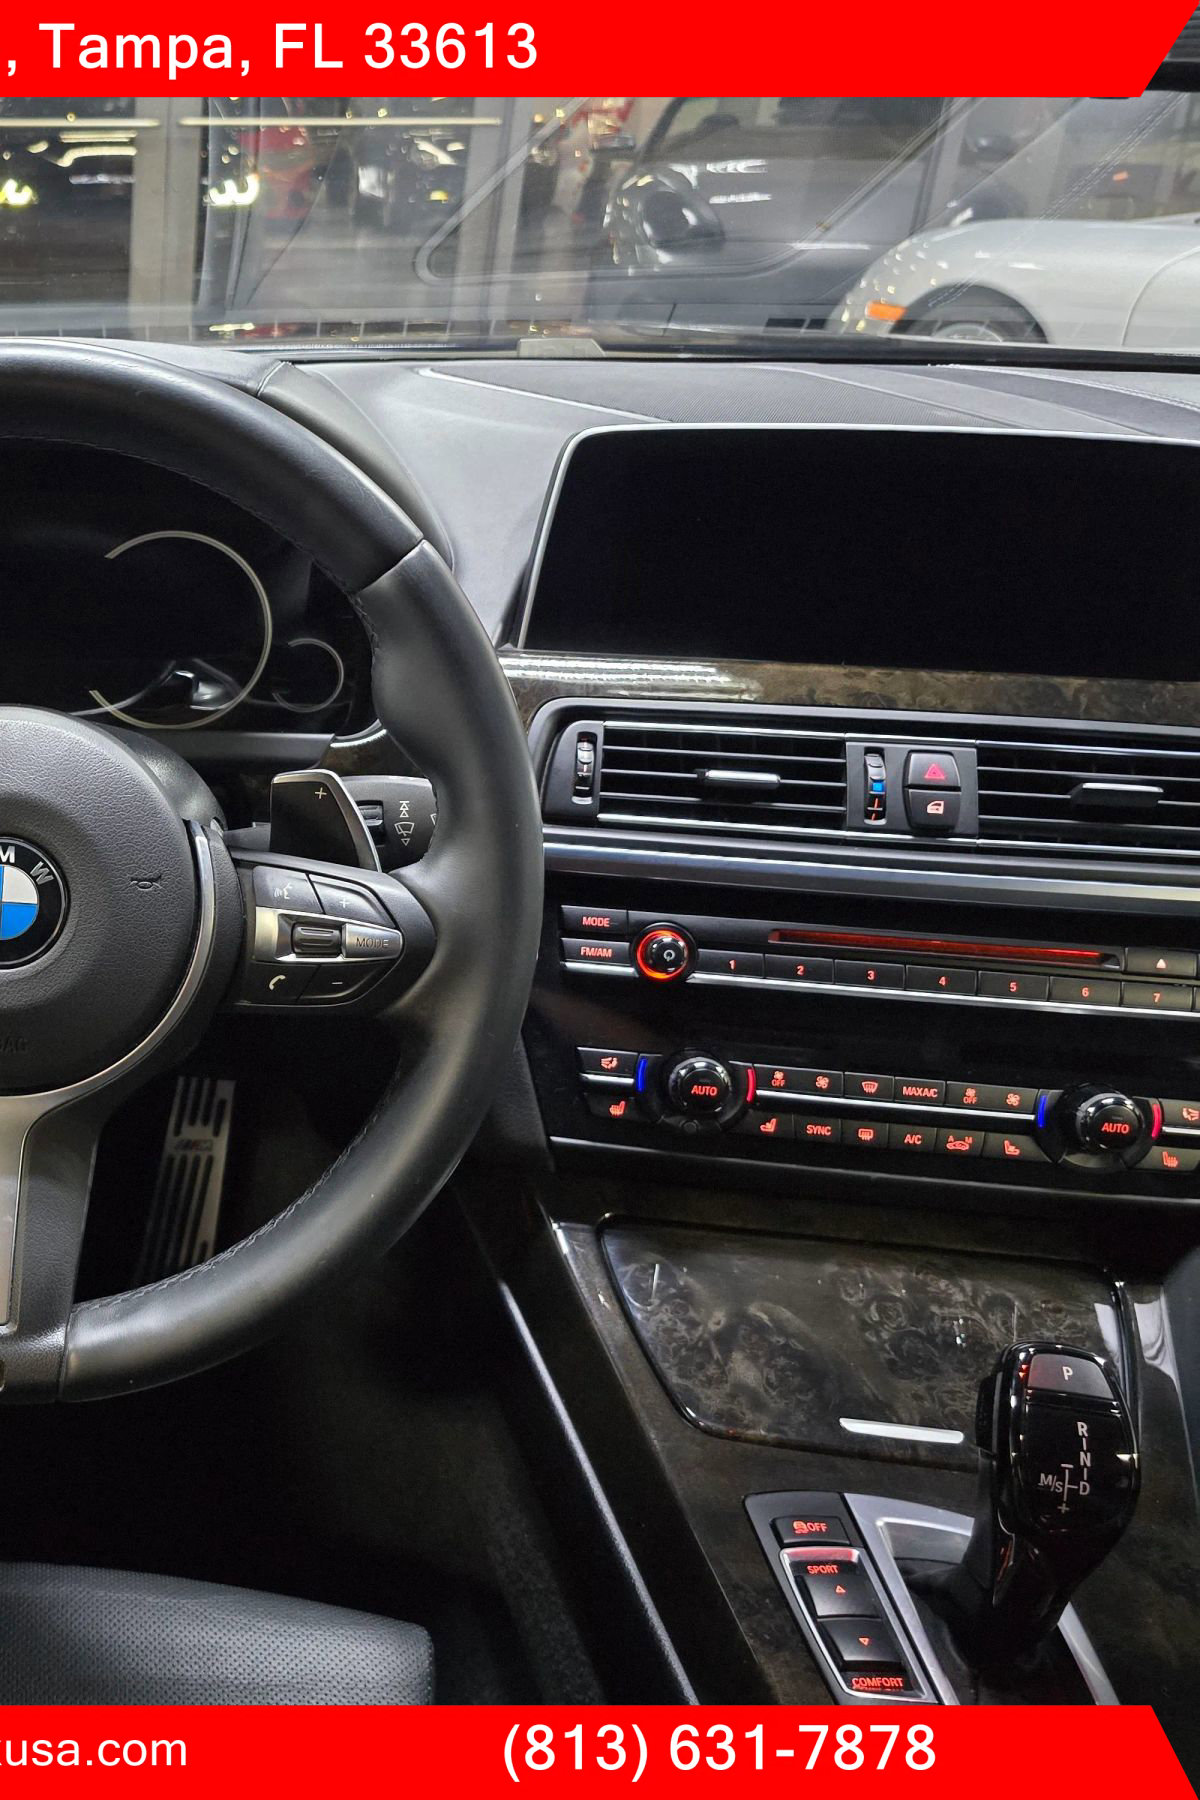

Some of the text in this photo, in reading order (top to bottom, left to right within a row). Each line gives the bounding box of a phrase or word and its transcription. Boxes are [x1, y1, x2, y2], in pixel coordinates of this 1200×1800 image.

[582, 916, 610, 928] MODE
[355, 936, 389, 949] MODE
[580, 946, 612, 958] FM/AM
[796, 965, 804, 976] 2
[867, 970, 875, 981] 3
[938, 976, 946, 986] 4
[1009, 981, 1017, 992] 5
[1081, 987, 1089, 998] 6
[1153, 992, 1161, 1003] 7
[771, 1078, 785, 1087] OFF
[691, 1085, 718, 1096] AUTO
[963, 1096, 977, 1105] OFF
[806, 1124, 832, 1136] SYNC
[1101, 1122, 1130, 1134] AUTO
[904, 1134, 922, 1145] A/C
[1062, 1366, 1073, 1380] P
[1077, 1421, 1088, 1437] R
[806, 1522, 828, 1533] OFF
[806, 1564, 839, 1575] SPORT
[851, 1677, 904, 1688] COMFORT
